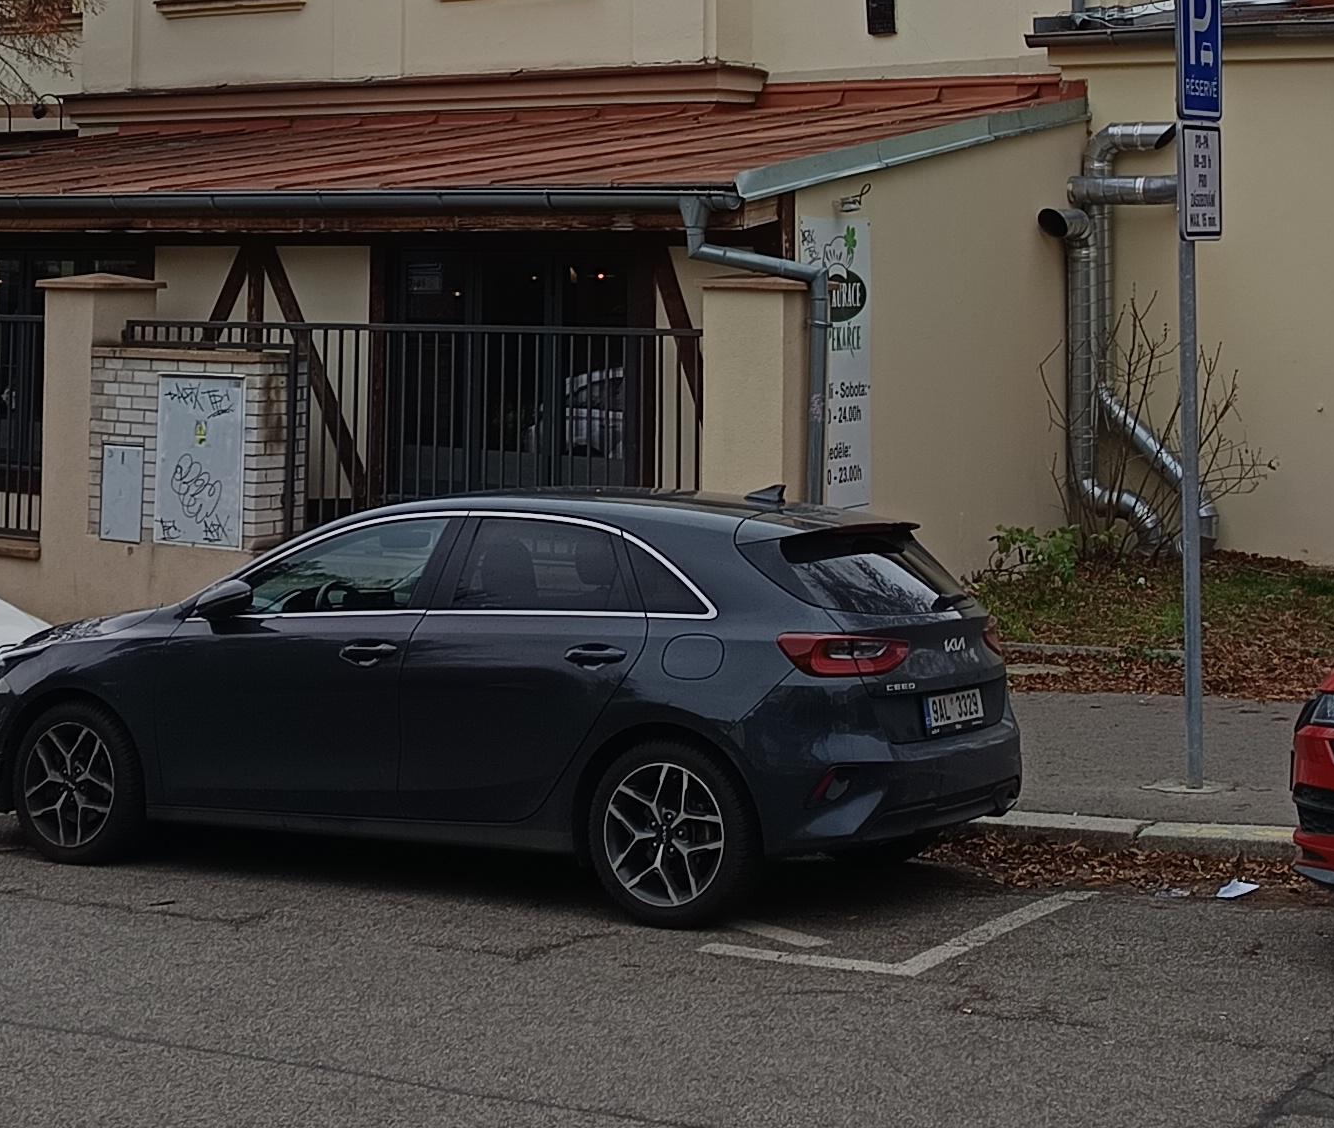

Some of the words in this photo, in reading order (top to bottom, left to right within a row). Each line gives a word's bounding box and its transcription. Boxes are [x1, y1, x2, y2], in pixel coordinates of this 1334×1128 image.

[1185, 75, 1218, 97] RÉSERVÉ
[828, 442, 851, 460] eděle:
[931, 696, 952, 723] 9AL
[955, 692, 979, 718] 3329
